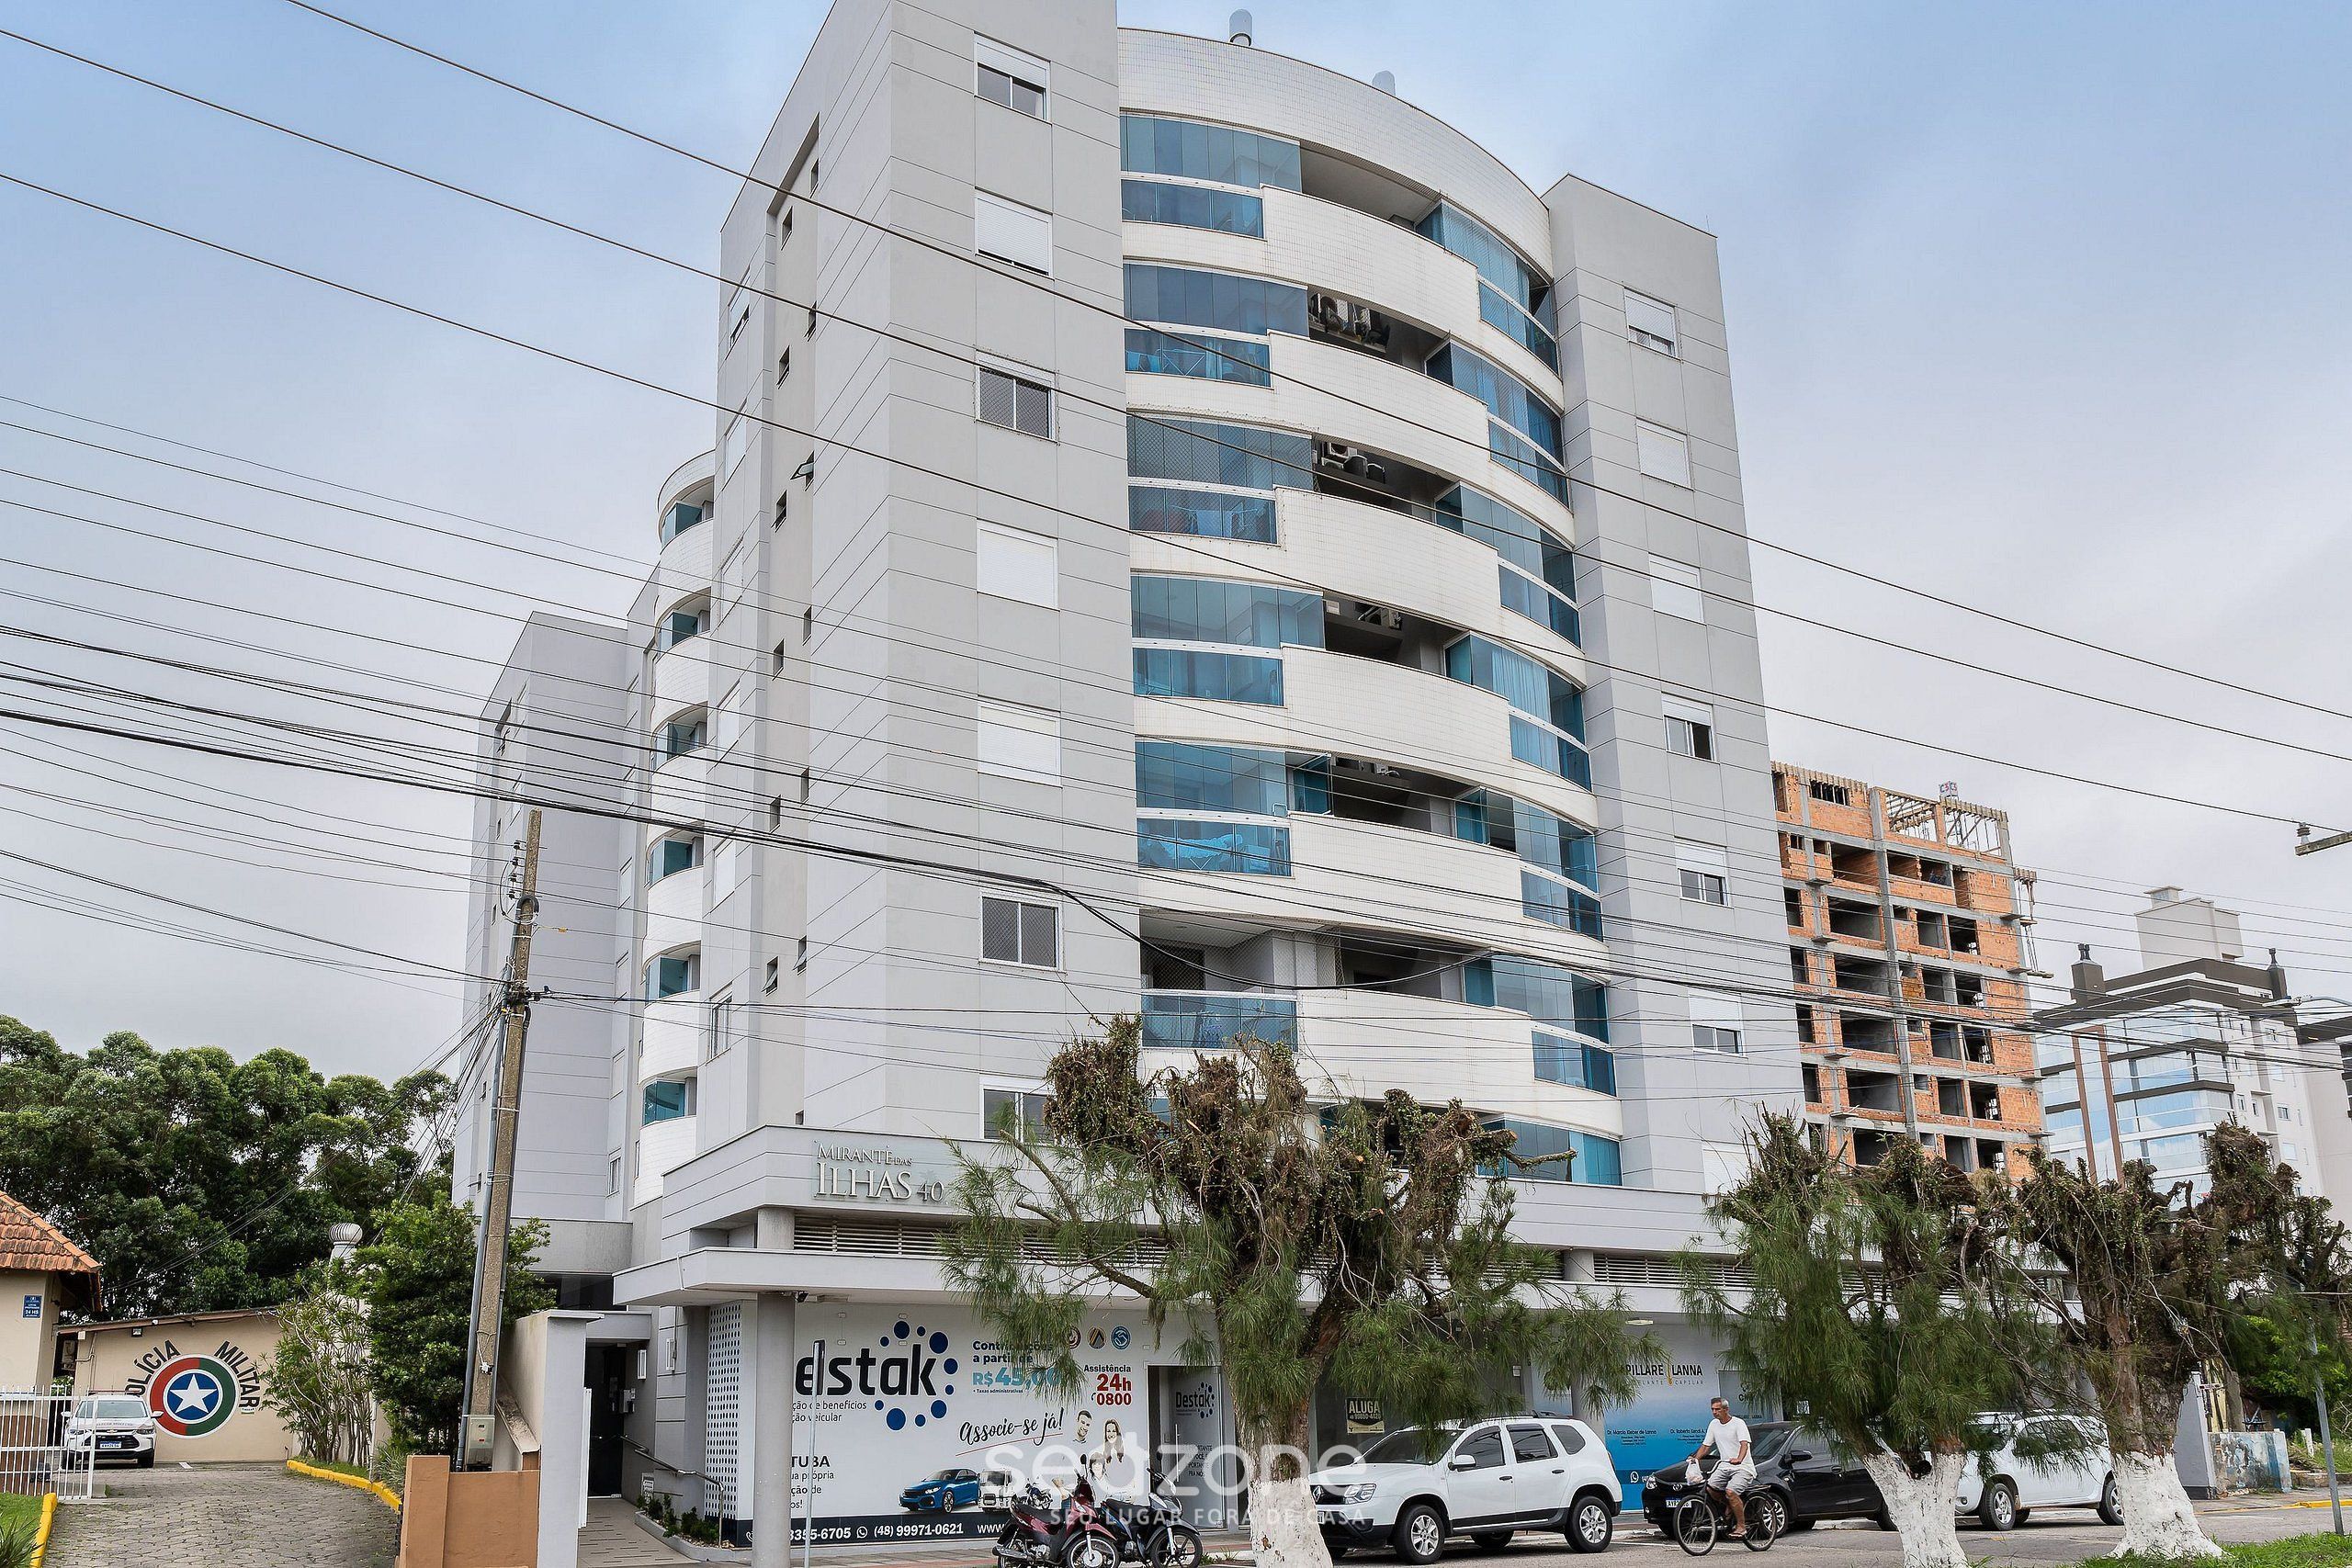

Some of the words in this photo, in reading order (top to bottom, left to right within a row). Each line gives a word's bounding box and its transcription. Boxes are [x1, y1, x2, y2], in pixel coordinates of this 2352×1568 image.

[817, 1143, 893, 1166] MIRANTE
[894, 1156, 912, 1167] DAS
[816, 1161, 912, 1200] ILHAS
[916, 1180, 945, 1202] 40
[972, 1355, 979, 1363] a
[983, 1353, 1012, 1365] parti
[125, 1339, 182, 1398] OLÍCIA
[213, 1340, 260, 1408] MILITAR
[795, 1343, 937, 1396] estak
[1084, 1364, 1131, 1372] Assistência
[1671, 1364, 1703, 1376] LANNA
[972, 1371, 993, 1387] R$
[1097, 1373, 1132, 1391] 24h
[822, 1399, 867, 1410] benefícios
[1096, 1393, 1132, 1405] 0800
[1176, 1390, 1211, 1408] Destak
[1349, 1400, 1380, 1414] ALUGA
[959, 1418, 1038, 1446] Associe-se
[1033, 1407, 1064, 1446] já!
[874, 1526, 894, 1538] (48)
[896, 1523, 964, 1537] 99971-0621
